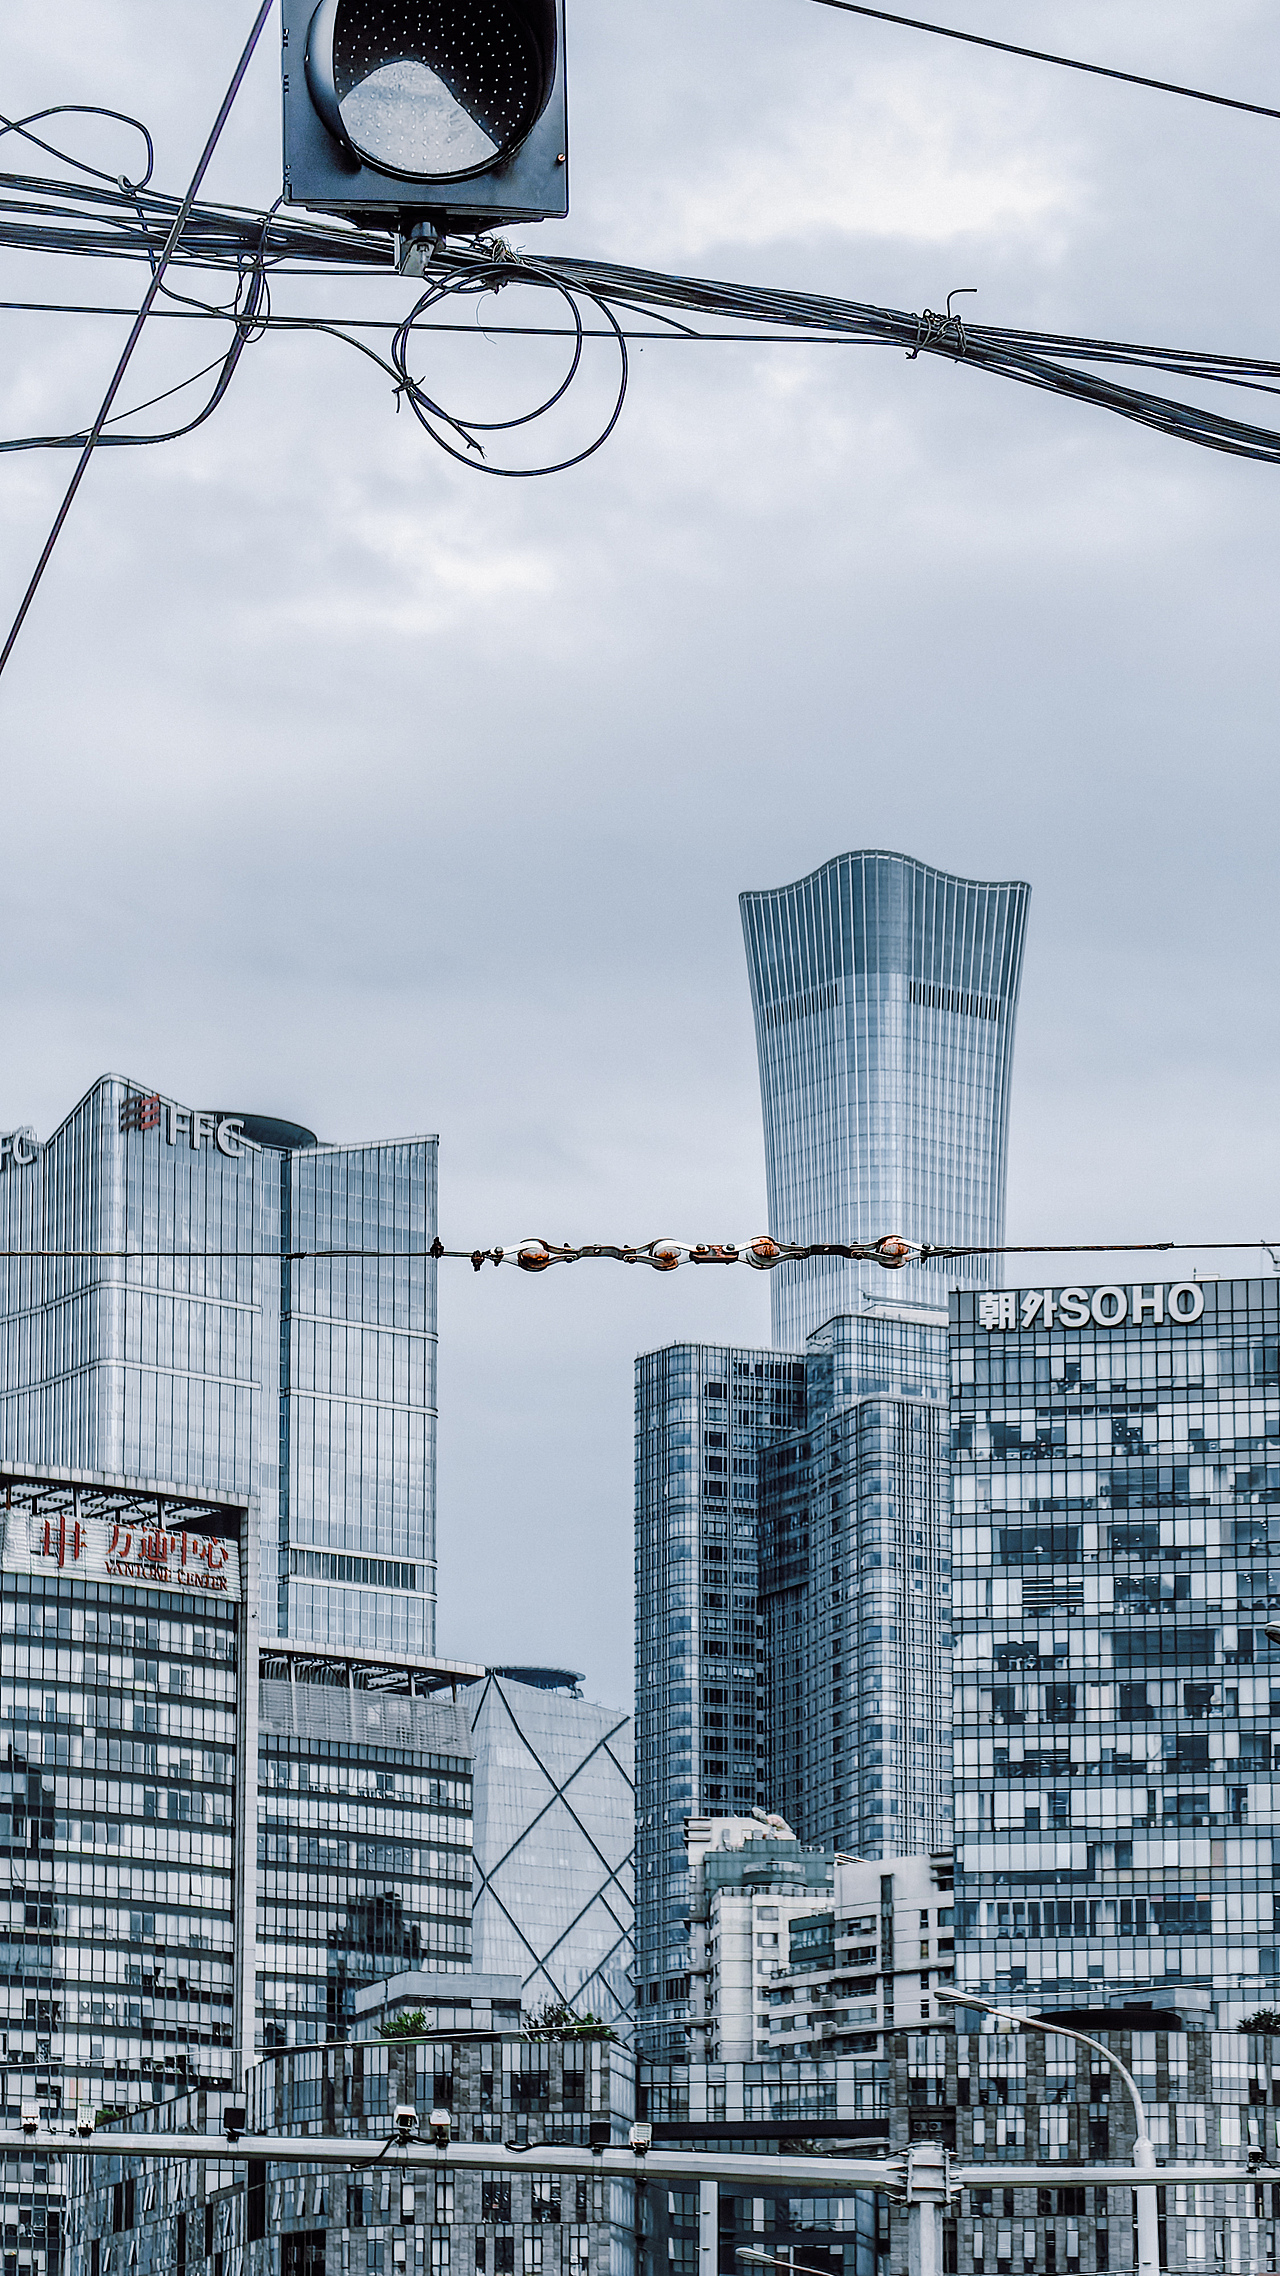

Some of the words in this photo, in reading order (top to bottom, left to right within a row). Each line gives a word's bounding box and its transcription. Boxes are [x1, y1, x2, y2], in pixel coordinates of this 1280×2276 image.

[167, 1103, 246, 1158] FFC
[105, 1524, 229, 1568] 万通中心
[104, 1560, 172, 1582] VANTONE
[177, 1569, 228, 1591] CENTER
